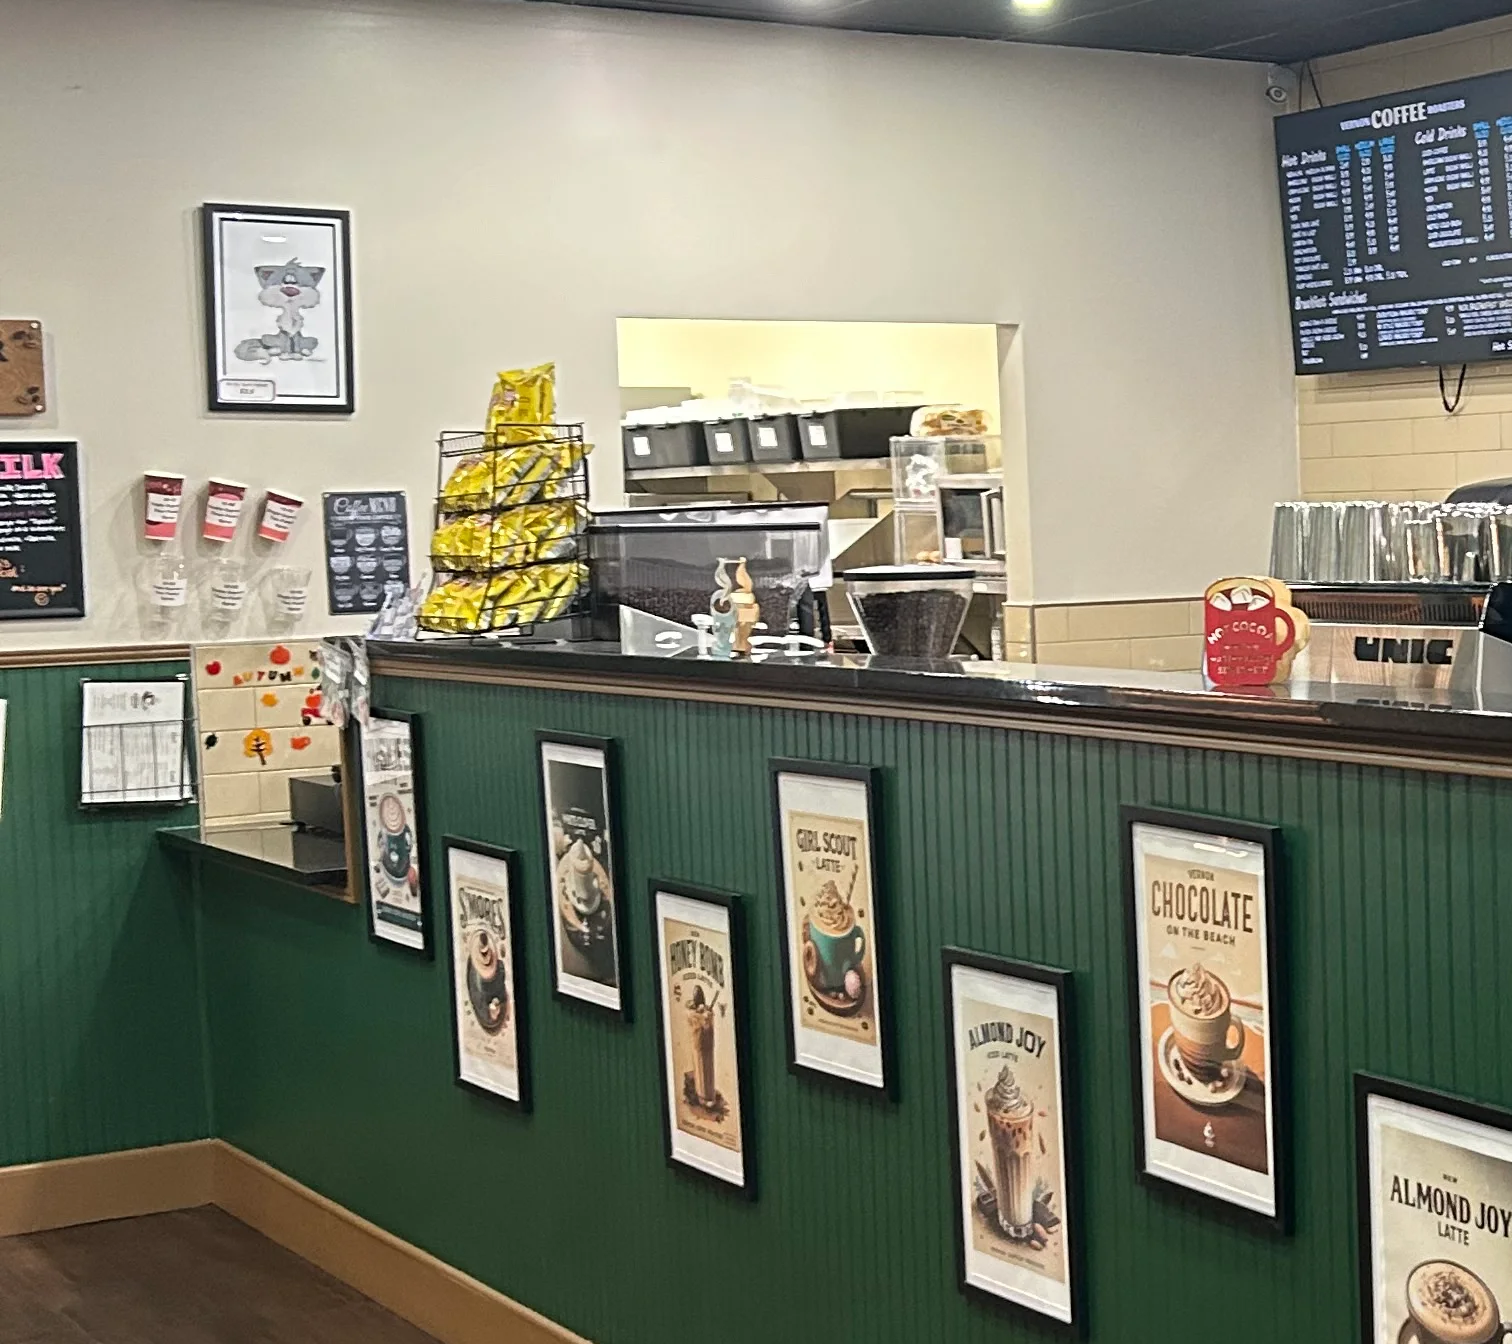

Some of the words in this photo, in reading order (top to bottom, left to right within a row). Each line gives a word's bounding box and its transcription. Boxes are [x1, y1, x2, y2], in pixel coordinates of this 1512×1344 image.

[1371, 101, 1427, 129] COFFEE
[1414, 130, 1436, 145] Cold
[1438, 126, 1467, 143] Drinks
[0, 452, 66, 480] ILK
[1354, 636, 1453, 665] UNIC
[822, 831, 858, 861] SCOUT
[815, 858, 842, 874] LATTE
[1151, 879, 1254, 935] CHOCOLATE
[1166, 924, 1180, 937] ON
[1181, 925, 1201, 942] THE
[1203, 928, 1237, 947] BEACH
[968, 1020, 1014, 1052] ALMOND
[1015, 1025, 1047, 1059] JOY
[1390, 1174, 1472, 1225] ALMOND
[1474, 1201, 1512, 1239] JOY
[1437, 1220, 1470, 1247] LATTE
